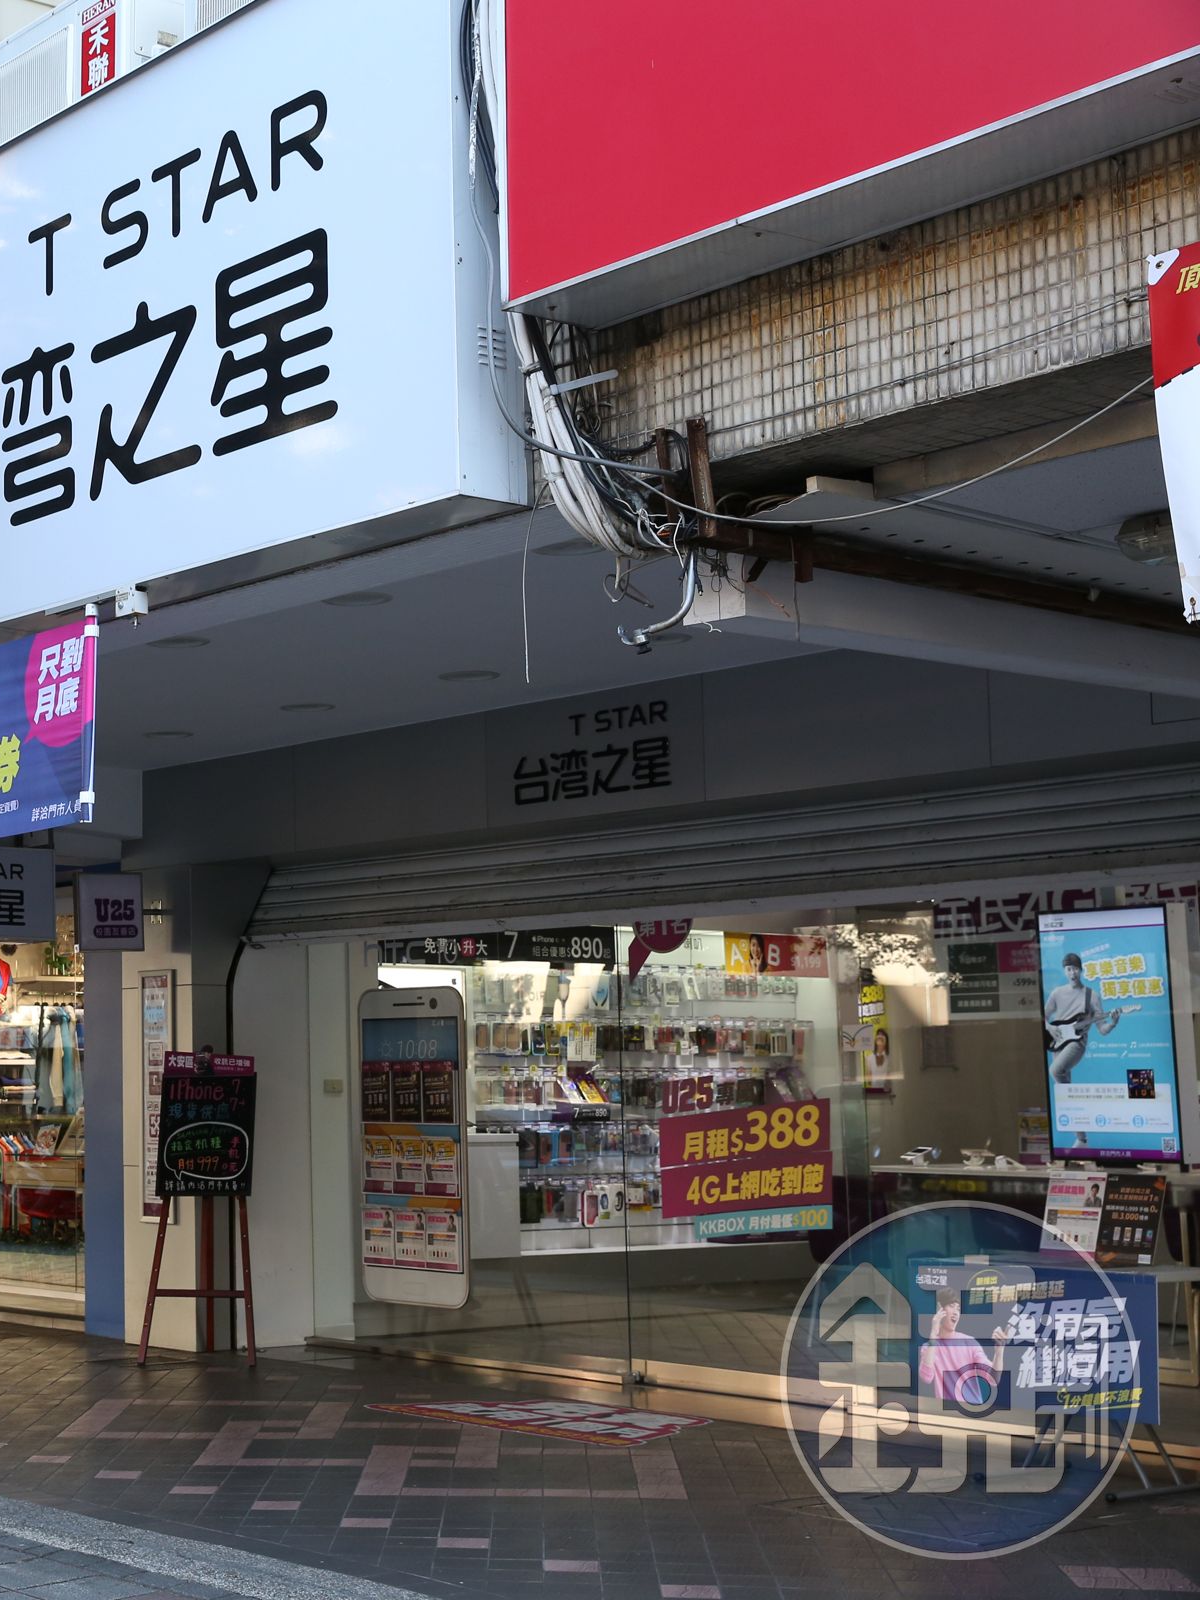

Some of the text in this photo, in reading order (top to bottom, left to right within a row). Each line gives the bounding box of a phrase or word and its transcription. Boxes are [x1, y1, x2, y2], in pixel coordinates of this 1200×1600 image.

[86, 20, 110, 90] 禾聯
[28, 89, 328, 296] T STAR
[37, 634, 86, 686] 只到
[33, 676, 80, 725] 月底
[568, 699, 669, 736] T STAR
[512, 736, 673, 806] 台湾之星
[94, 898, 135, 923] U25
[168, 1054, 195, 1069] 大安區
[662, 1075, 714, 1115] U25
[682, 1104, 821, 1162] 月租$388
[686, 1163, 825, 1206] 4G上網吃到飽
[699, 1216, 746, 1236] KKBOX
